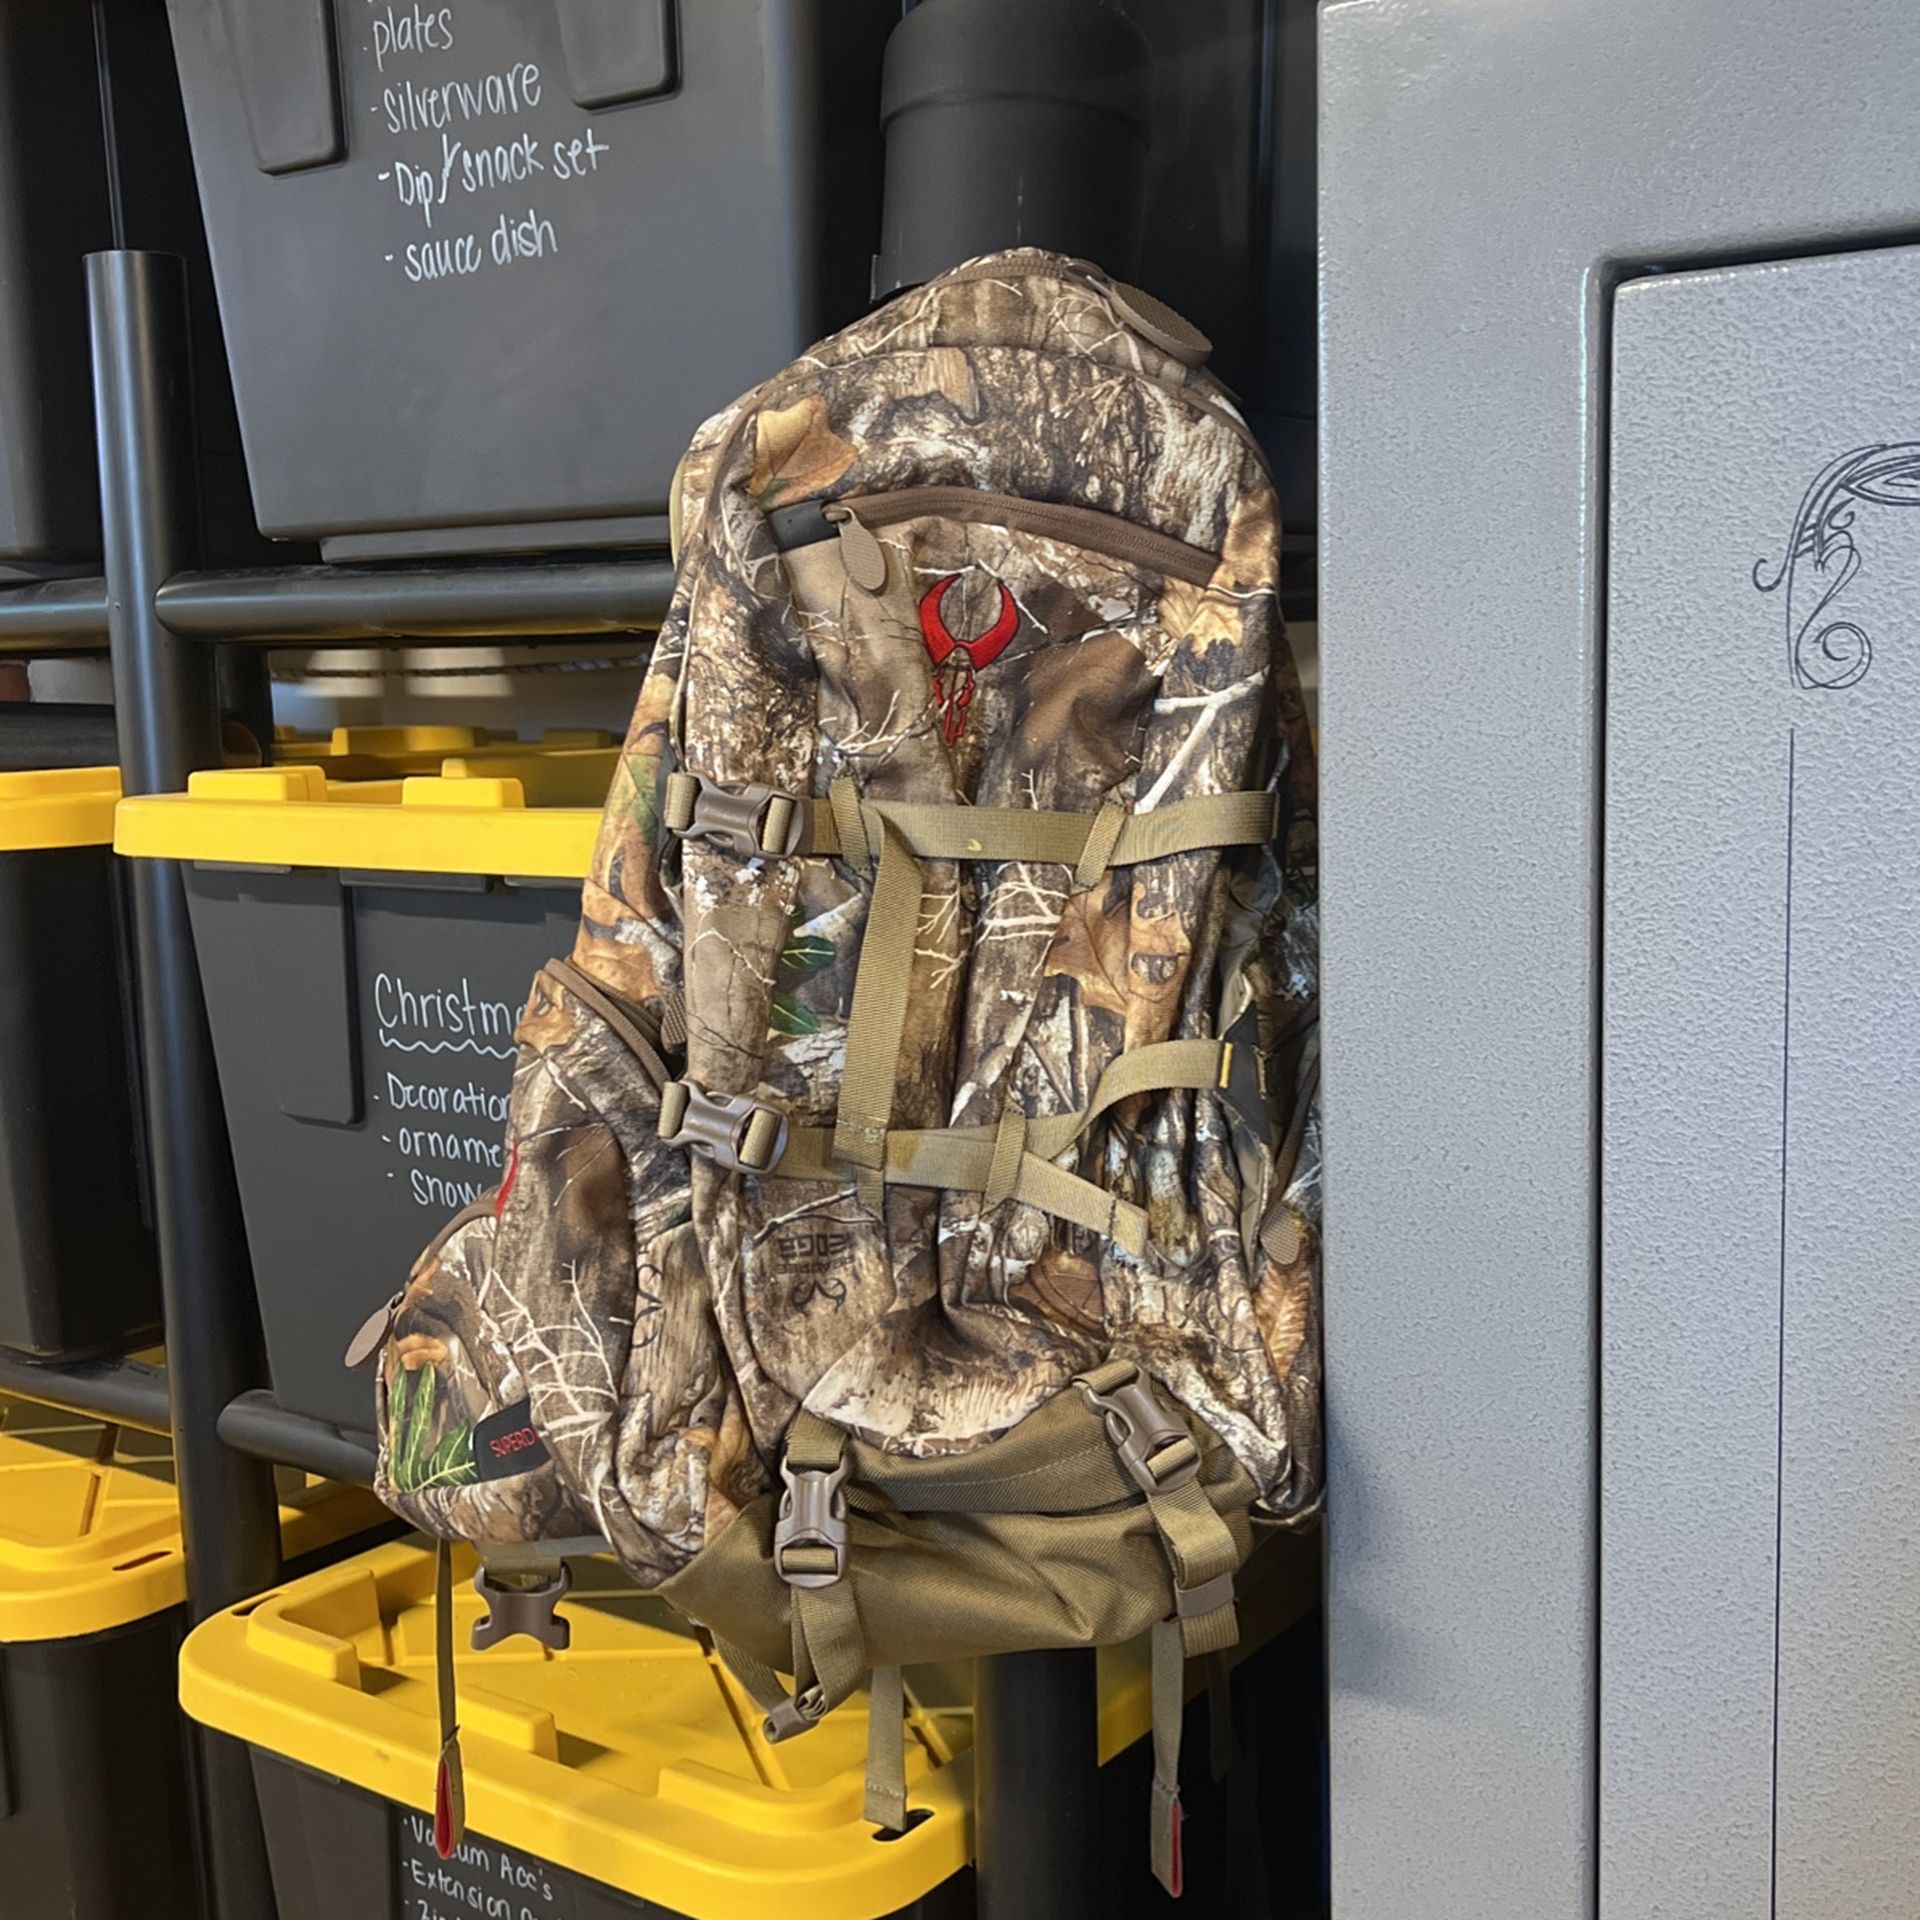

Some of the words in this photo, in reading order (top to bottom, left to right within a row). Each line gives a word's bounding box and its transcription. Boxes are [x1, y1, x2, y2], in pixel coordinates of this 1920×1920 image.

[373, 3, 453, 72] plates
[383, 63, 541, 133] silverware
[553, 128, 610, 179] set
[404, 235, 481, 281] sauce
[491, 208, 558, 264] dish
[489, 1427, 540, 1457] SUPERD
[411, 1859, 511, 1920] Extension
